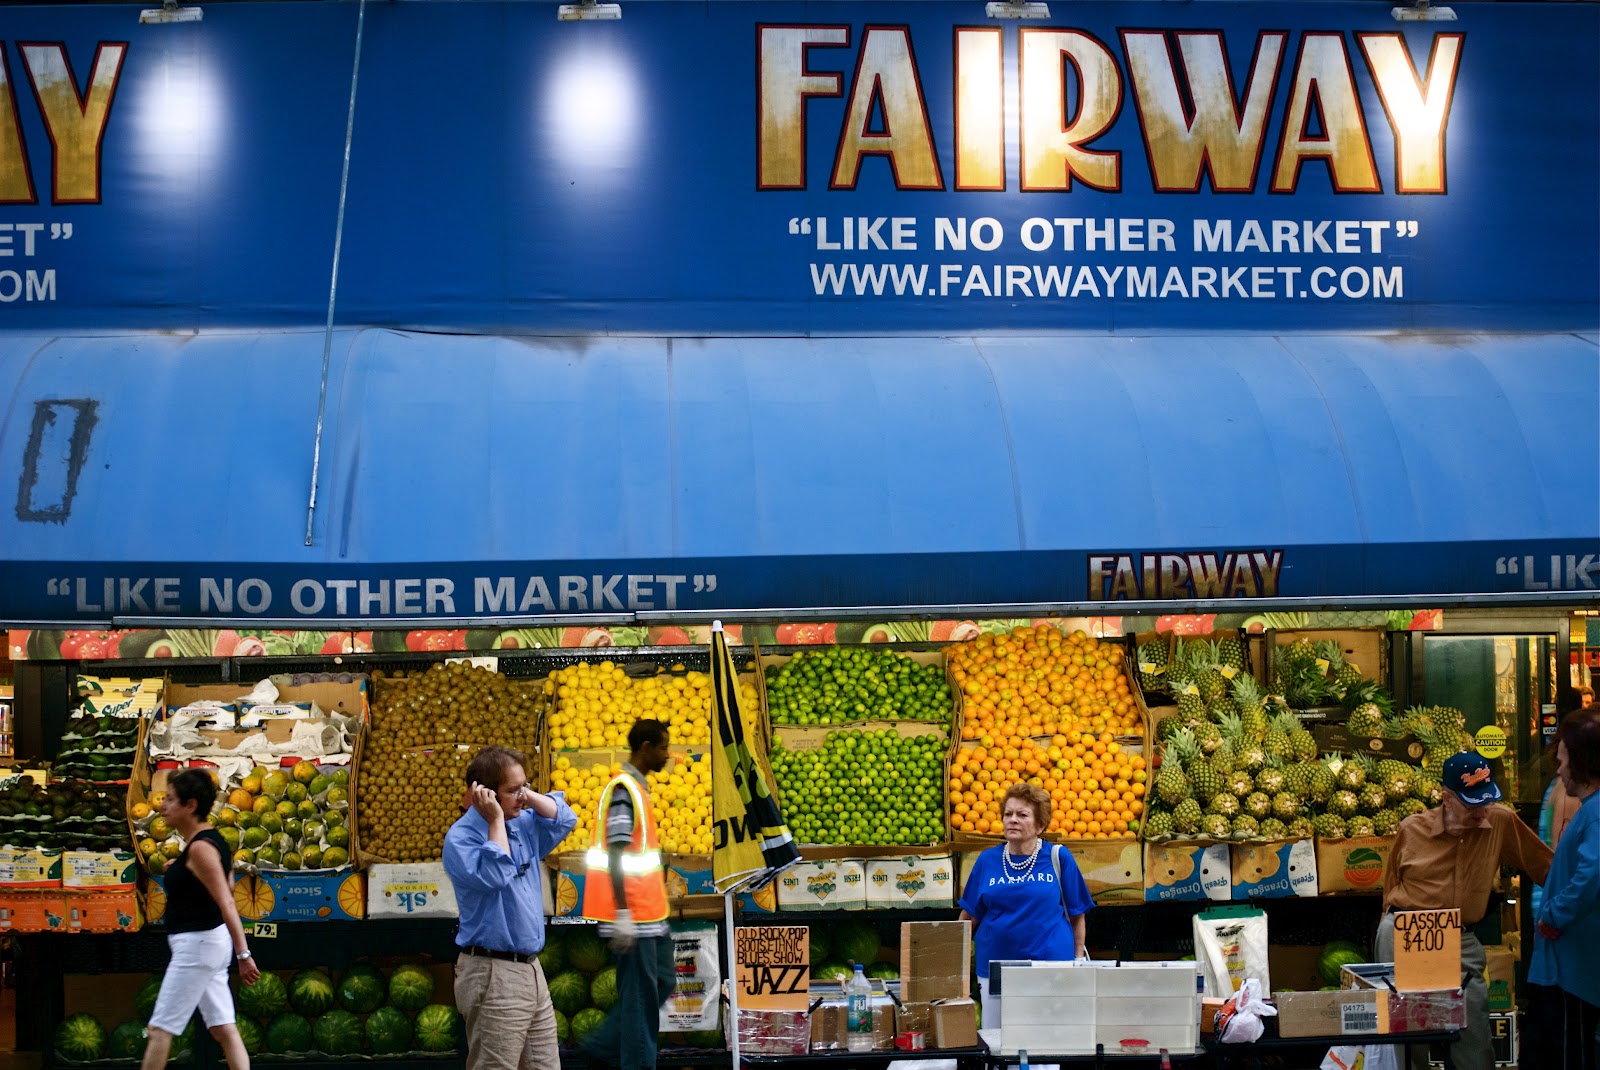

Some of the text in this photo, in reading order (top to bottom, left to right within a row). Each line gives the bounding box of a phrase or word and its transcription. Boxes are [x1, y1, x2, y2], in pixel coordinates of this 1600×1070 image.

[756, 24, 1466, 195] FAIRWAY
[788, 216, 1418, 254] “LIKE NO OTHER MARKET”
[810, 263, 1404, 299] WWW.FAIRWAYMARKET.COM
[1088, 550, 1284, 600] FAIRWAY
[1495, 553, 1600, 590] “LIK
[46, 574, 717, 615] “LIKE NO OTHER MARKET”
[102, 699, 133, 716] Super
[844, 874, 861, 883] FRESH
[872, 874, 888, 882] LIMES
[933, 871, 949, 881] FRESH
[989, 872, 1054, 886] BARNARD
[1247, 872, 1315, 896] Fresh Oranges
[287, 886, 322, 896] Sicor
[1159, 877, 1228, 899] Fresh Oranges
[286, 908, 317, 917] Citrus
[1394, 911, 1462, 931] CLASSICAL
[737, 927, 807, 940] OLD ROCK/POP
[1402, 929, 1444, 952] $4.00
[773, 951, 804, 963] SHOW
[1342, 1004, 1365, 1012] 04173
